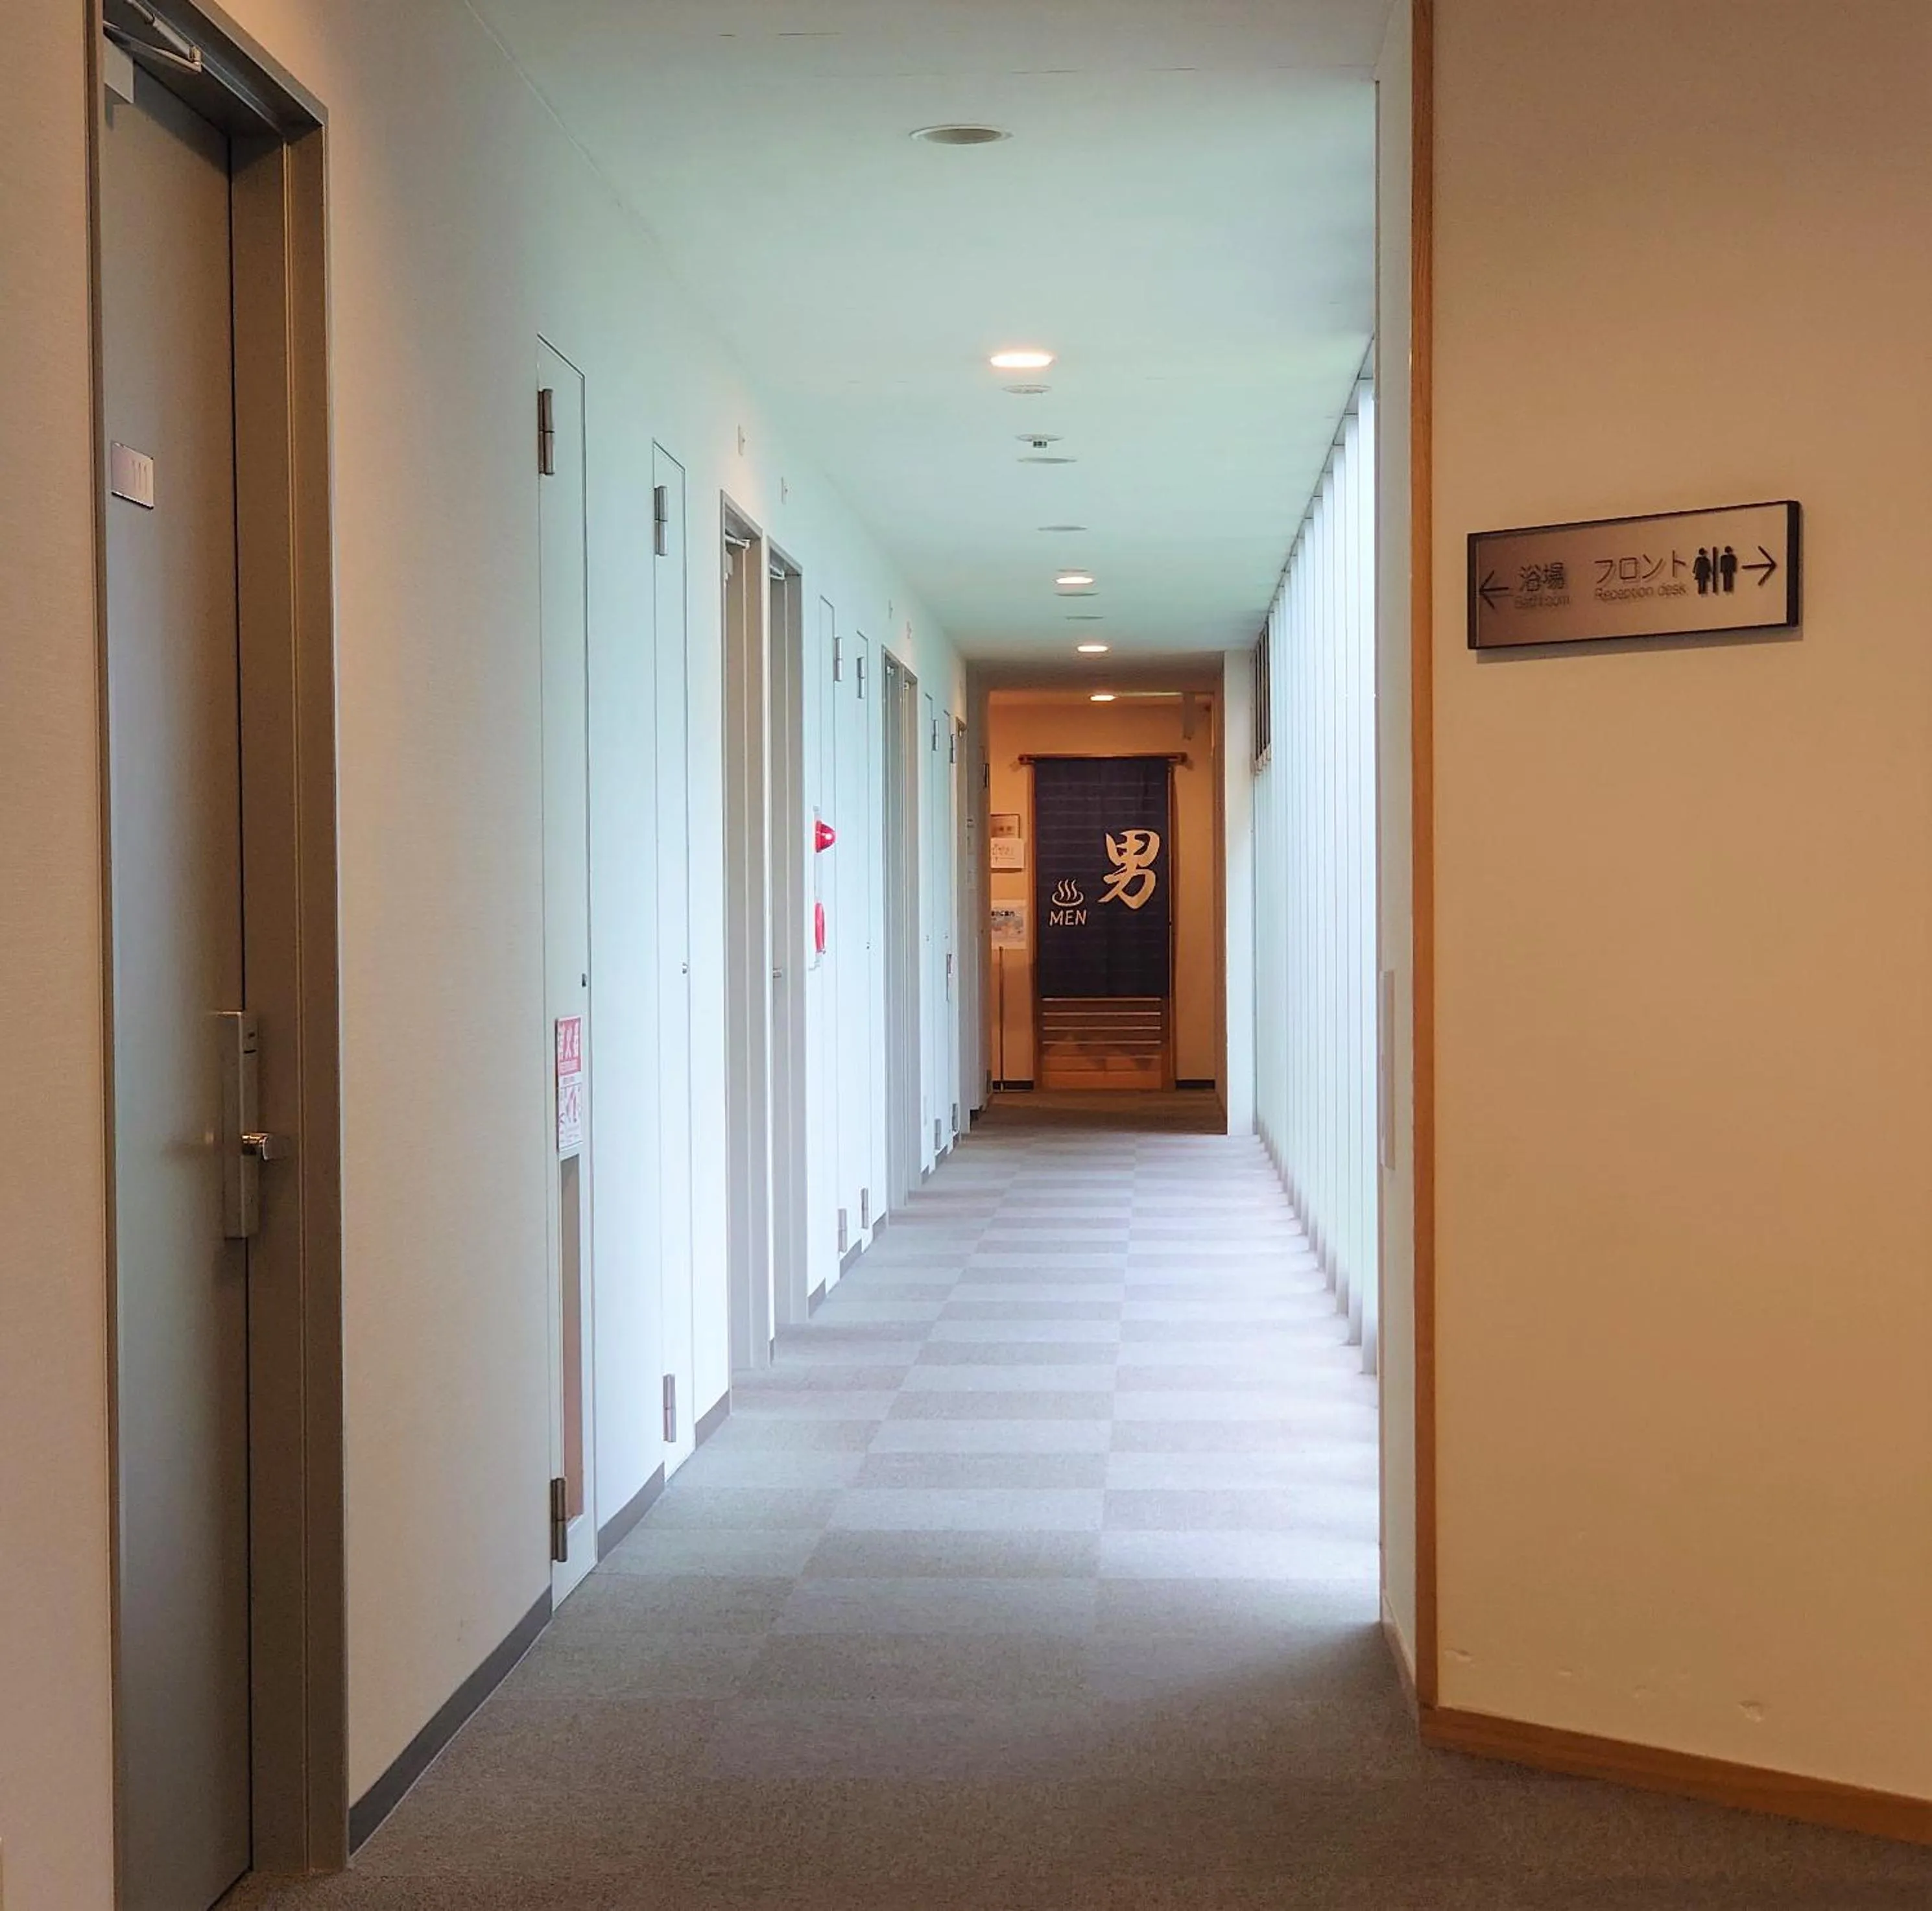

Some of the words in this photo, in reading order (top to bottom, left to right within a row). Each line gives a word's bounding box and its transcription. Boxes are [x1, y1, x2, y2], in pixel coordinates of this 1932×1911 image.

[1518, 562, 1564, 591] 浴場
[1594, 550, 1686, 584] フロント
[1097, 829, 1160, 909] 男
[1049, 909, 1086, 926] MEN
